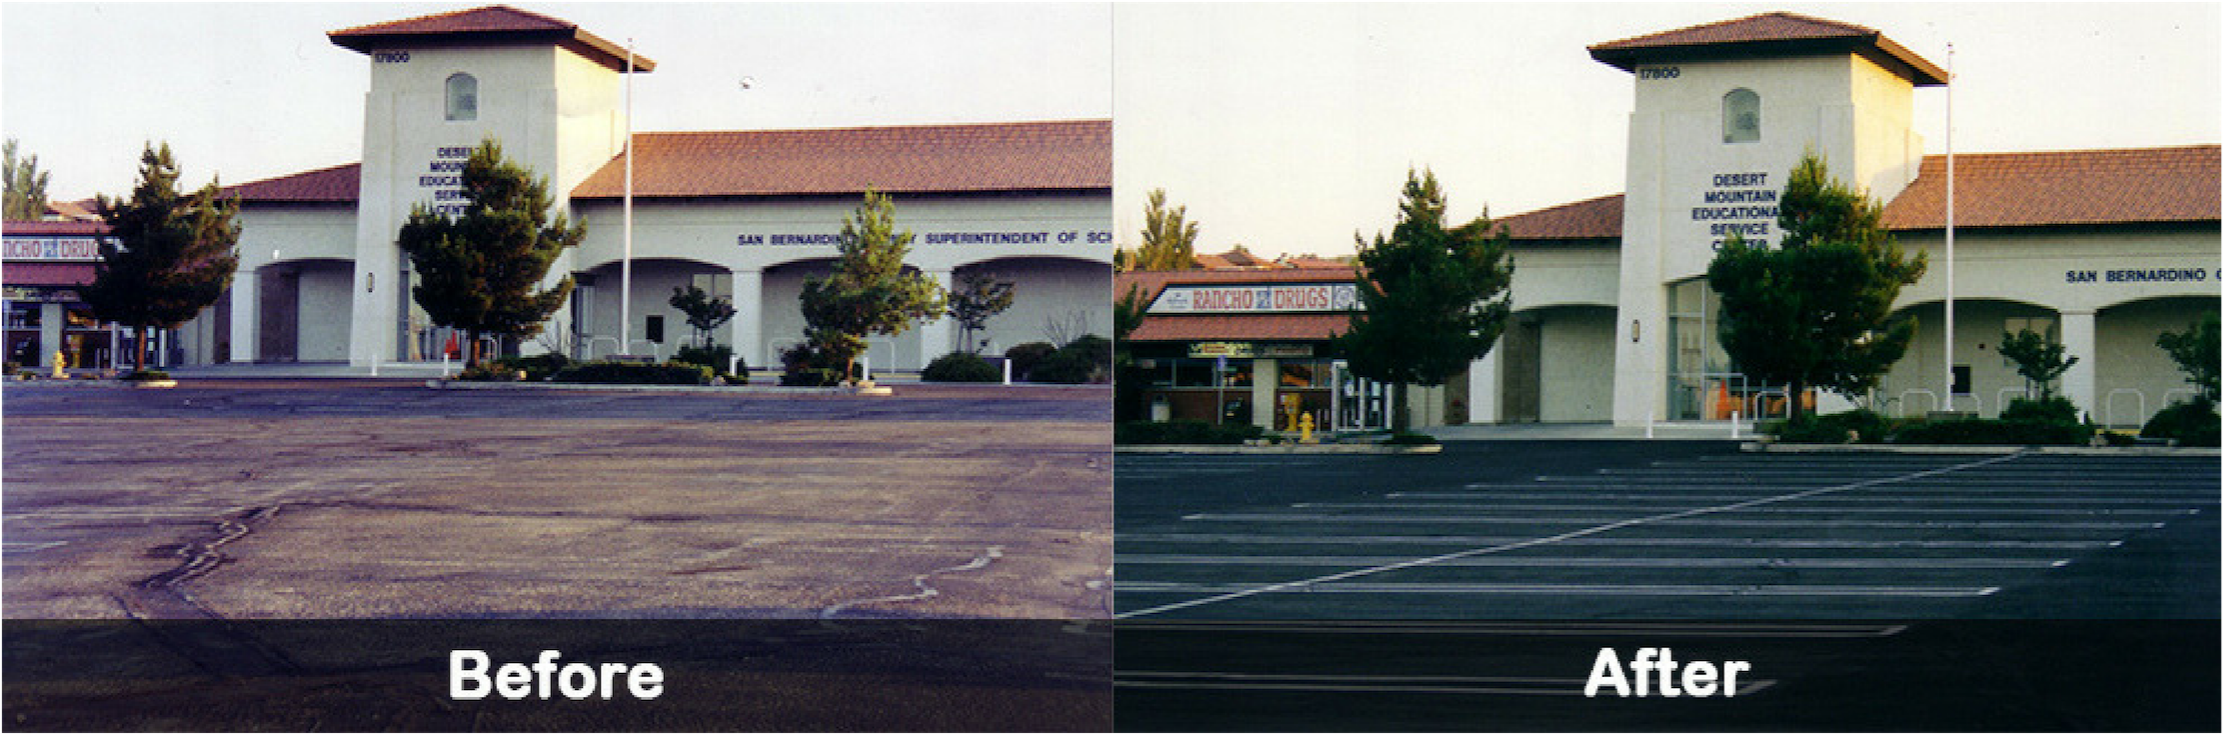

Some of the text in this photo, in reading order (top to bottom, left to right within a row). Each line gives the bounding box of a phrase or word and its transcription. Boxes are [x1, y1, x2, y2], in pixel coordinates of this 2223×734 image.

[1641, 67, 1680, 80] 17800
[1713, 172, 1767, 187] DESERT
[1704, 190, 1776, 203] MOUNTAIN
[1711, 222, 1769, 236] SERVICE
[738, 234, 764, 246] SAN
[925, 232, 1050, 244] SUPERINTENDENT
[1057, 231, 1078, 244] OF
[2066, 270, 2097, 283] SAN
[2106, 268, 2206, 282] BERNARDINO
[1193, 289, 1253, 310] RANCHO
[1275, 288, 1329, 309] DRUGS
